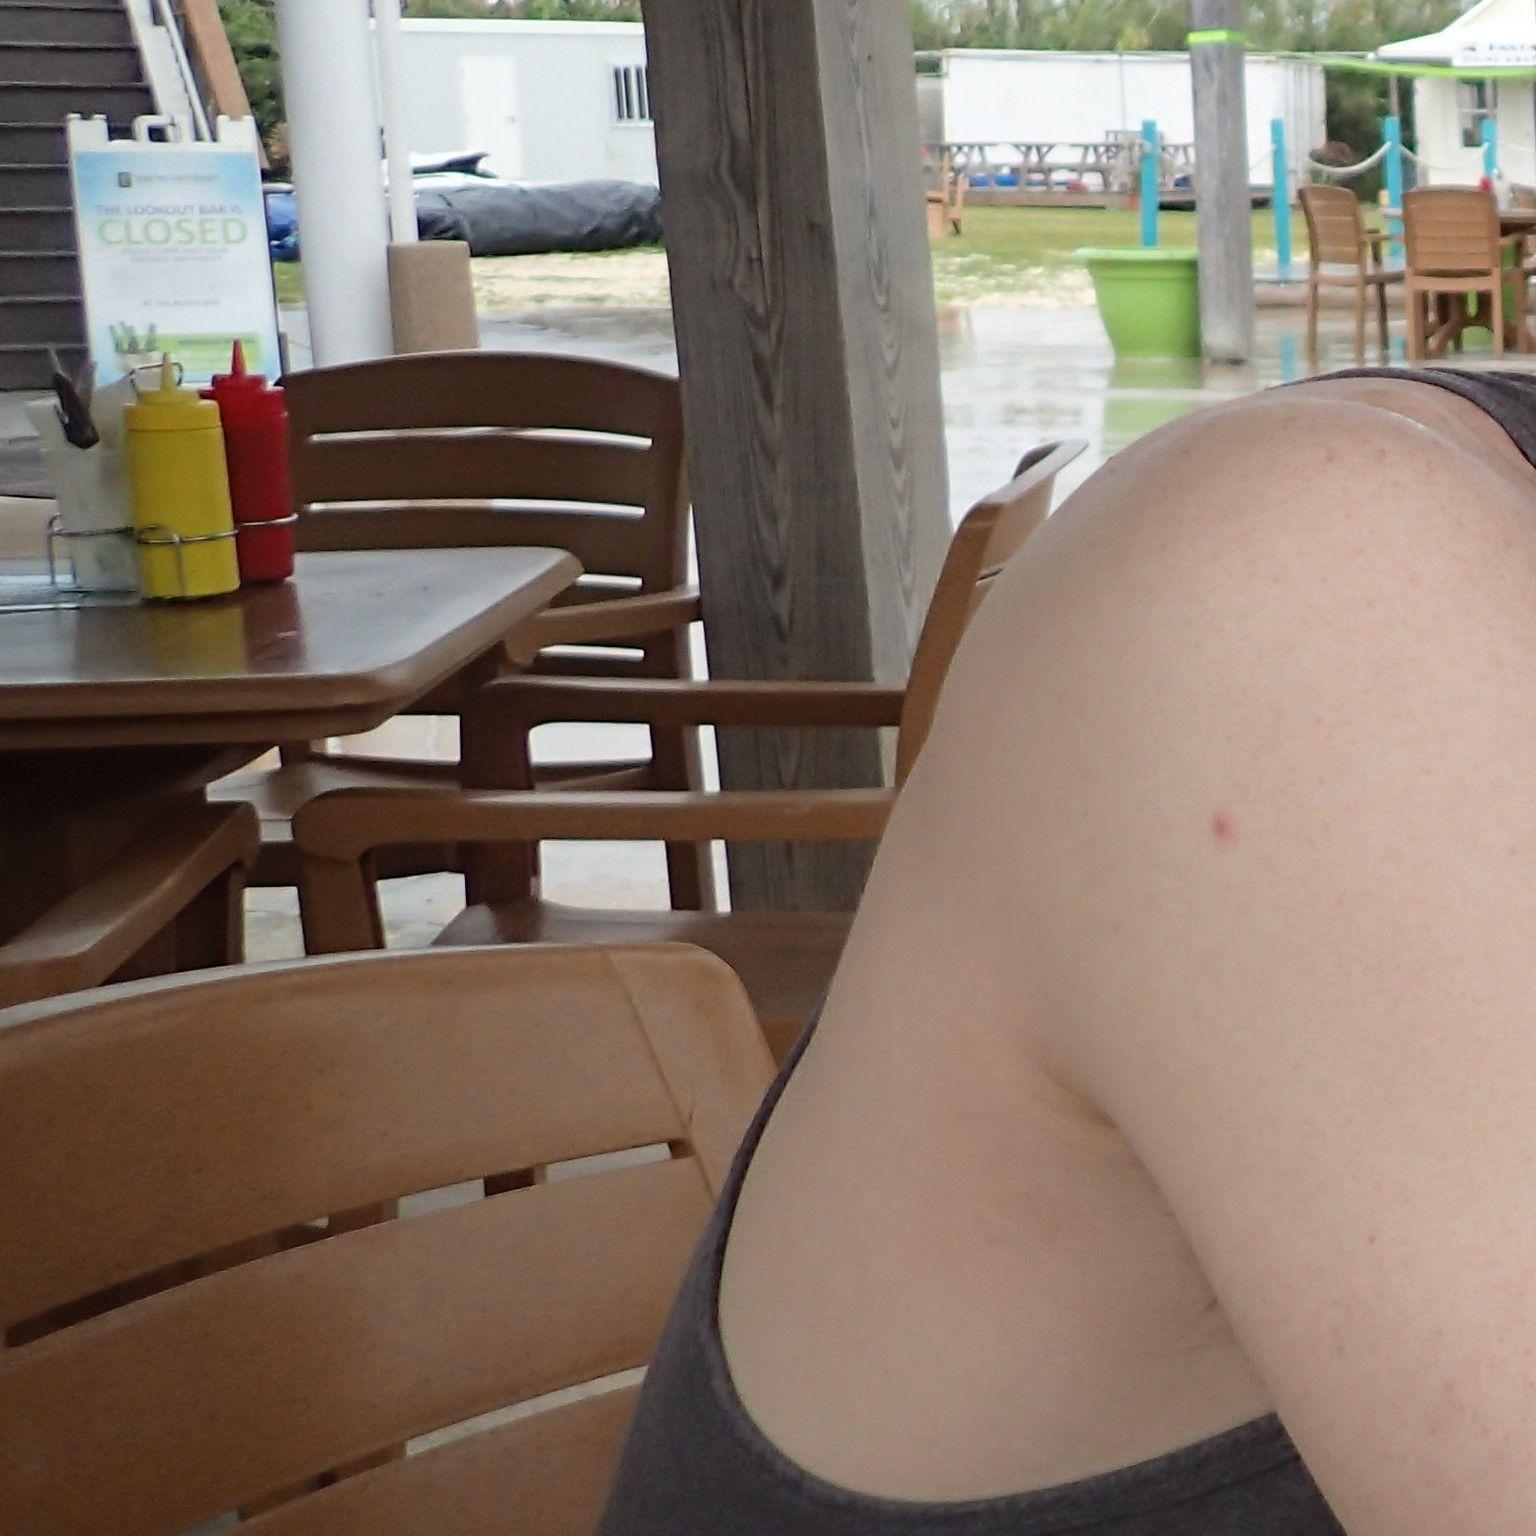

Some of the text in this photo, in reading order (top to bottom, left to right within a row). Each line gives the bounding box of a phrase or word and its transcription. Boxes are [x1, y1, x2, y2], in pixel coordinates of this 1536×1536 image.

[95, 204, 243, 215] THE LOOKOUT BAR IS
[98, 217, 249, 245] CLOSED
